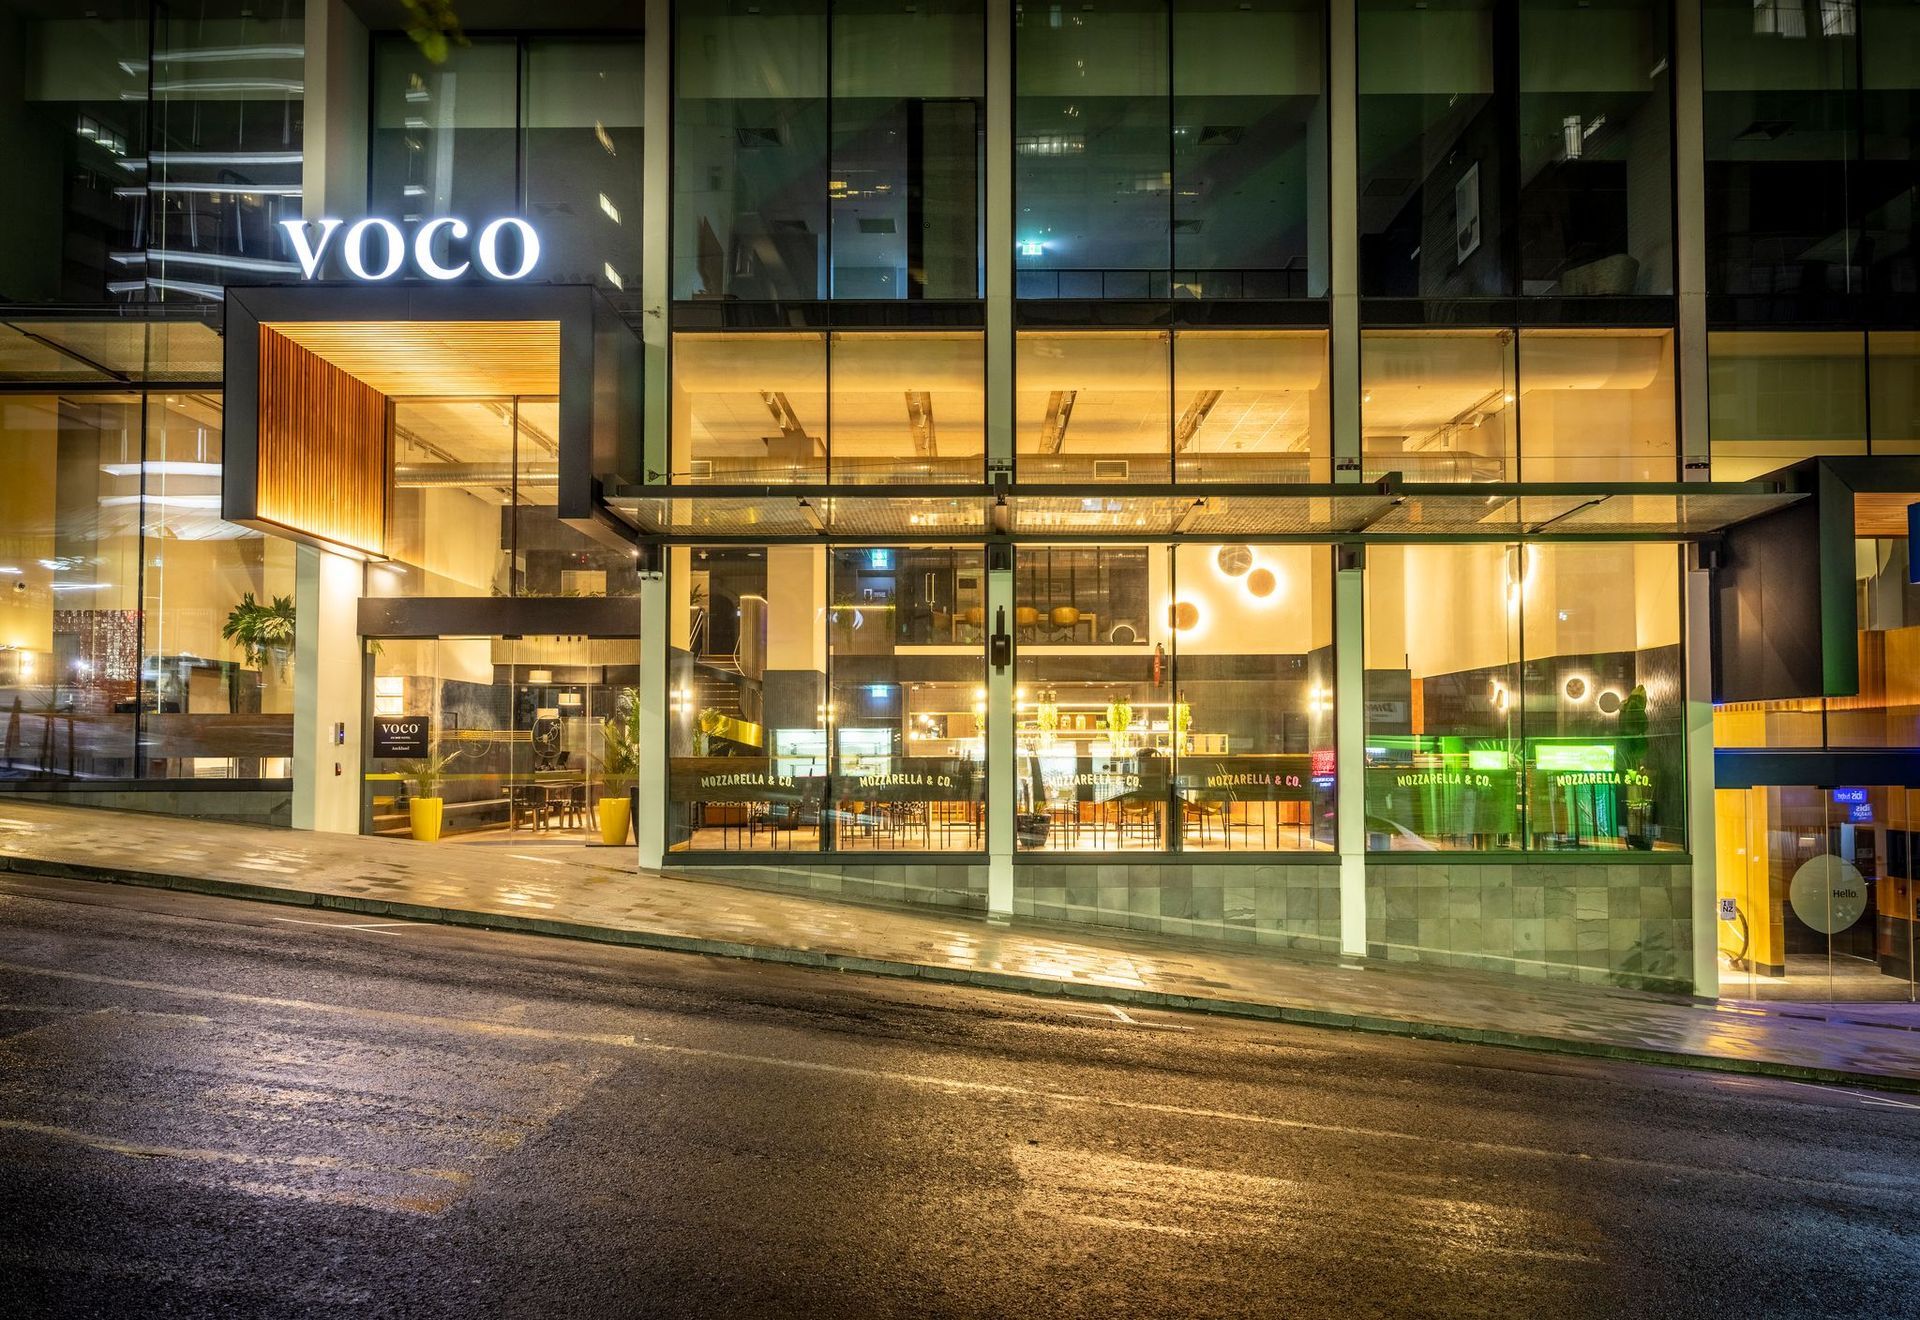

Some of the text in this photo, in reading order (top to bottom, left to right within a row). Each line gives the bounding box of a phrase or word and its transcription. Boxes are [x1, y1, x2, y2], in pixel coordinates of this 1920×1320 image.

[701, 773, 795, 788] MOZZARELLA & CO.
[859, 773, 953, 788] MOZZARELLA & CO.
[1126, 775, 1142, 788] CO.
[1207, 773, 1271, 788] MOZZARELLA
[1274, 775, 1281, 786] &
[1285, 775, 1302, 788] CO.
[1397, 773, 1492, 788] MOZZARELLA & CO.
[1556, 772, 1652, 787] MOZZARELLA & CO.
[1832, 889, 1859, 898] Hello.
